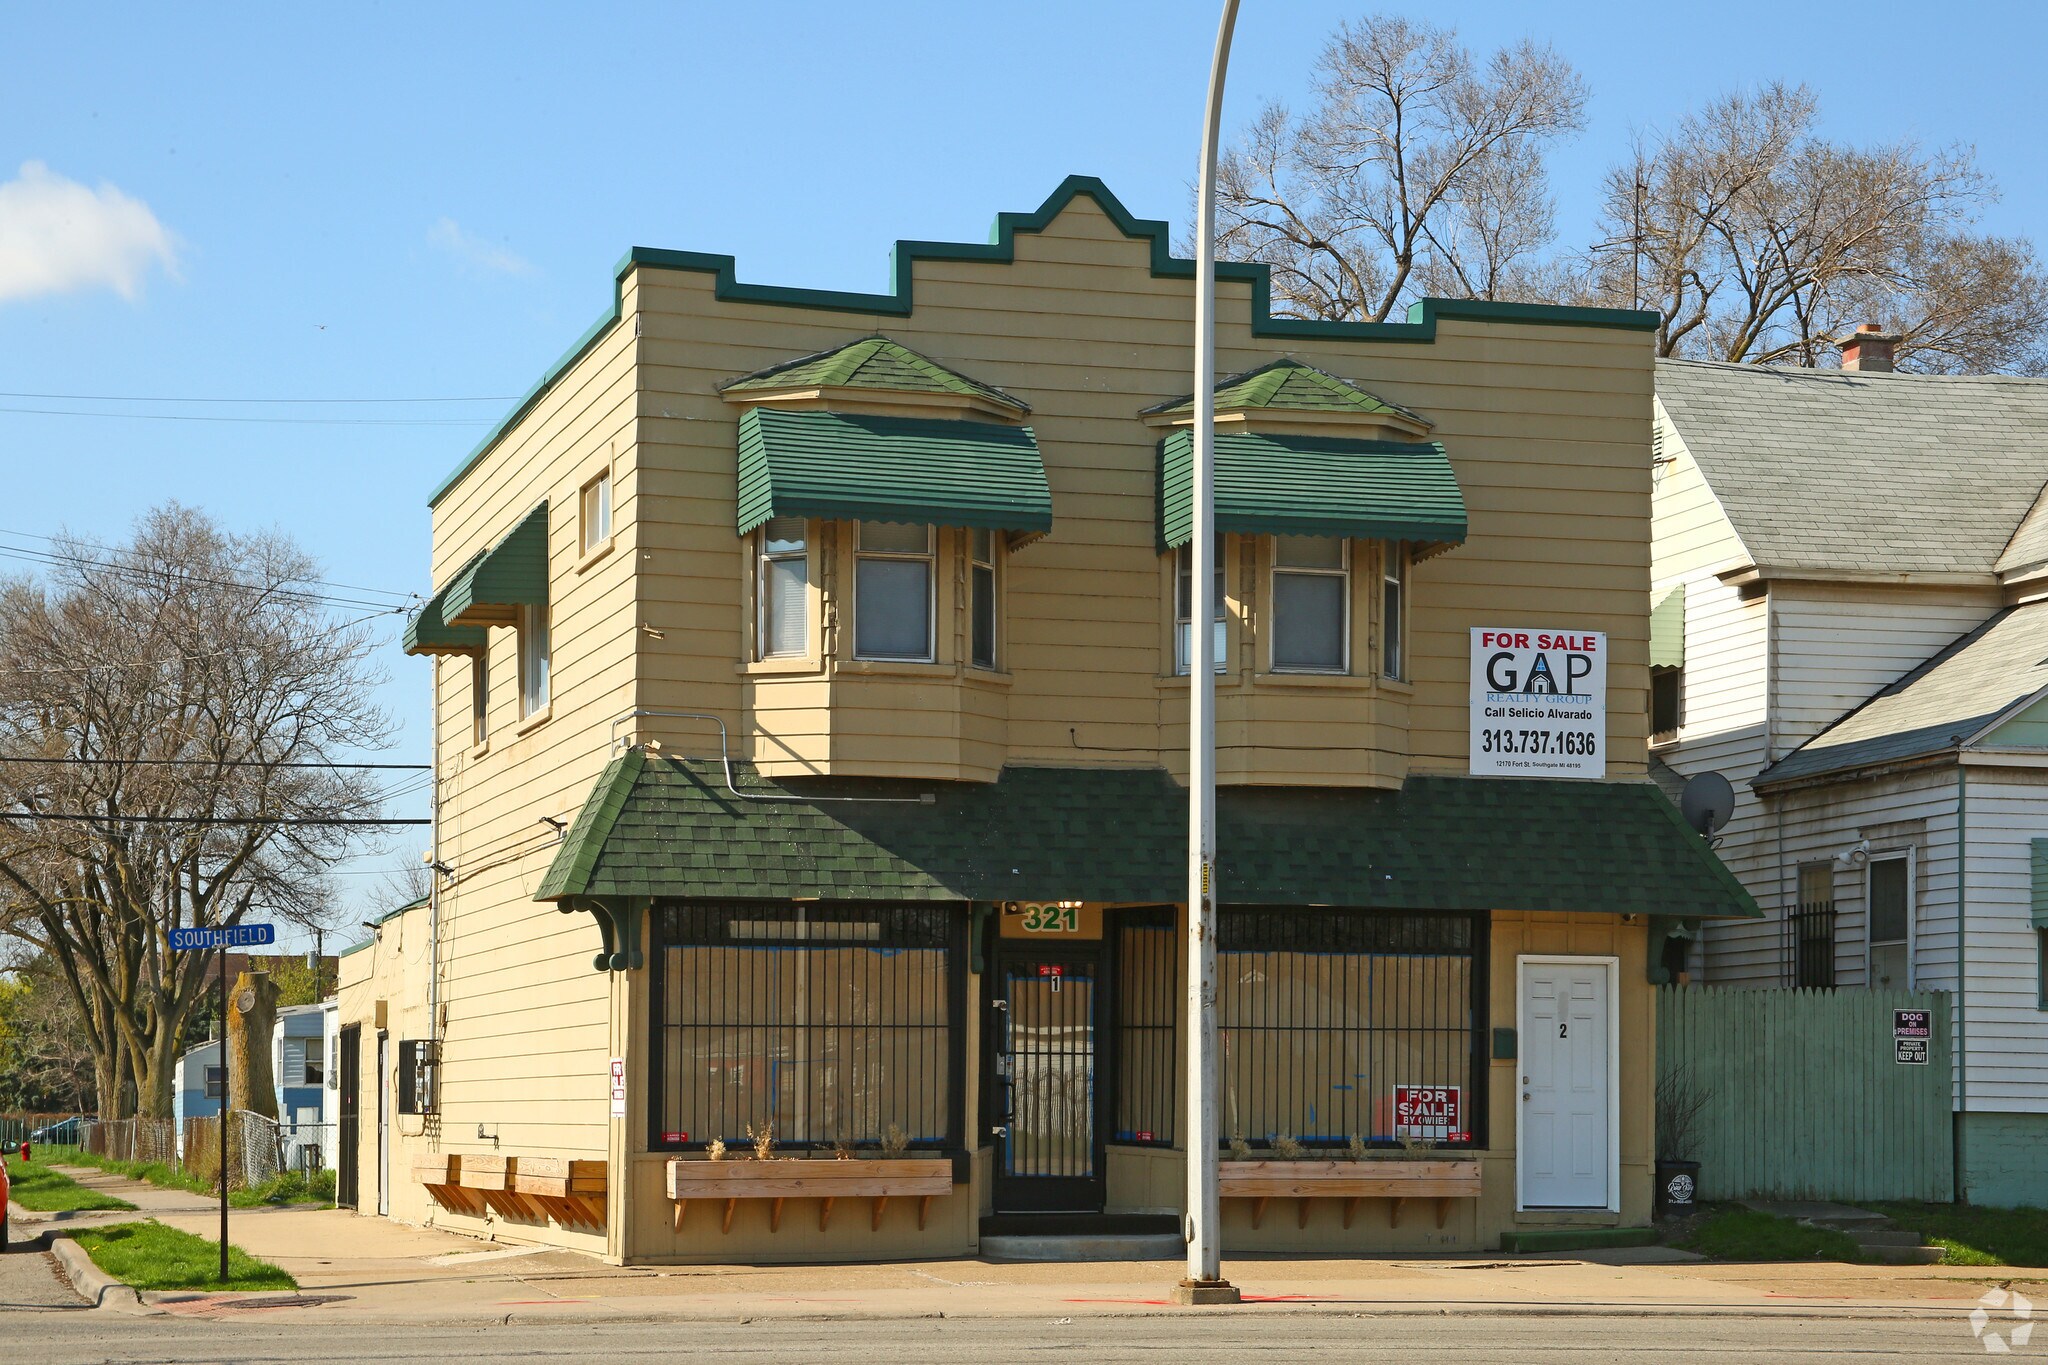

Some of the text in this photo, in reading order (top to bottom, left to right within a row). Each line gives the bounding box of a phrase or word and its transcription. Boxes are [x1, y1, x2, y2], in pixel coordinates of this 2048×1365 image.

[1482, 632, 1596, 651] FOR SALE
[1486, 652, 1592, 695] GAP
[1486, 693, 1592, 705] REALTY GROUP
[1485, 707, 1592, 720] Call Selicio Alvarado
[1482, 728, 1596, 756] 313.737.1636
[1532, 761, 1558, 769] Southgate
[1023, 904, 1078, 932] 321
[174, 927, 267, 947] SOUTHFIELD
[1052, 976, 1058, 991] 1
[1901, 1013, 1923, 1021] DOG
[1559, 1023, 1567, 1038] 2
[1897, 1028, 1928, 1036] PREMISES
[1898, 1051, 1926, 1061] KEEP OUT
[1406, 1090, 1448, 1102] FOR
[1398, 1102, 1455, 1116] SALE
[1403, 1116, 1416, 1124] BY
